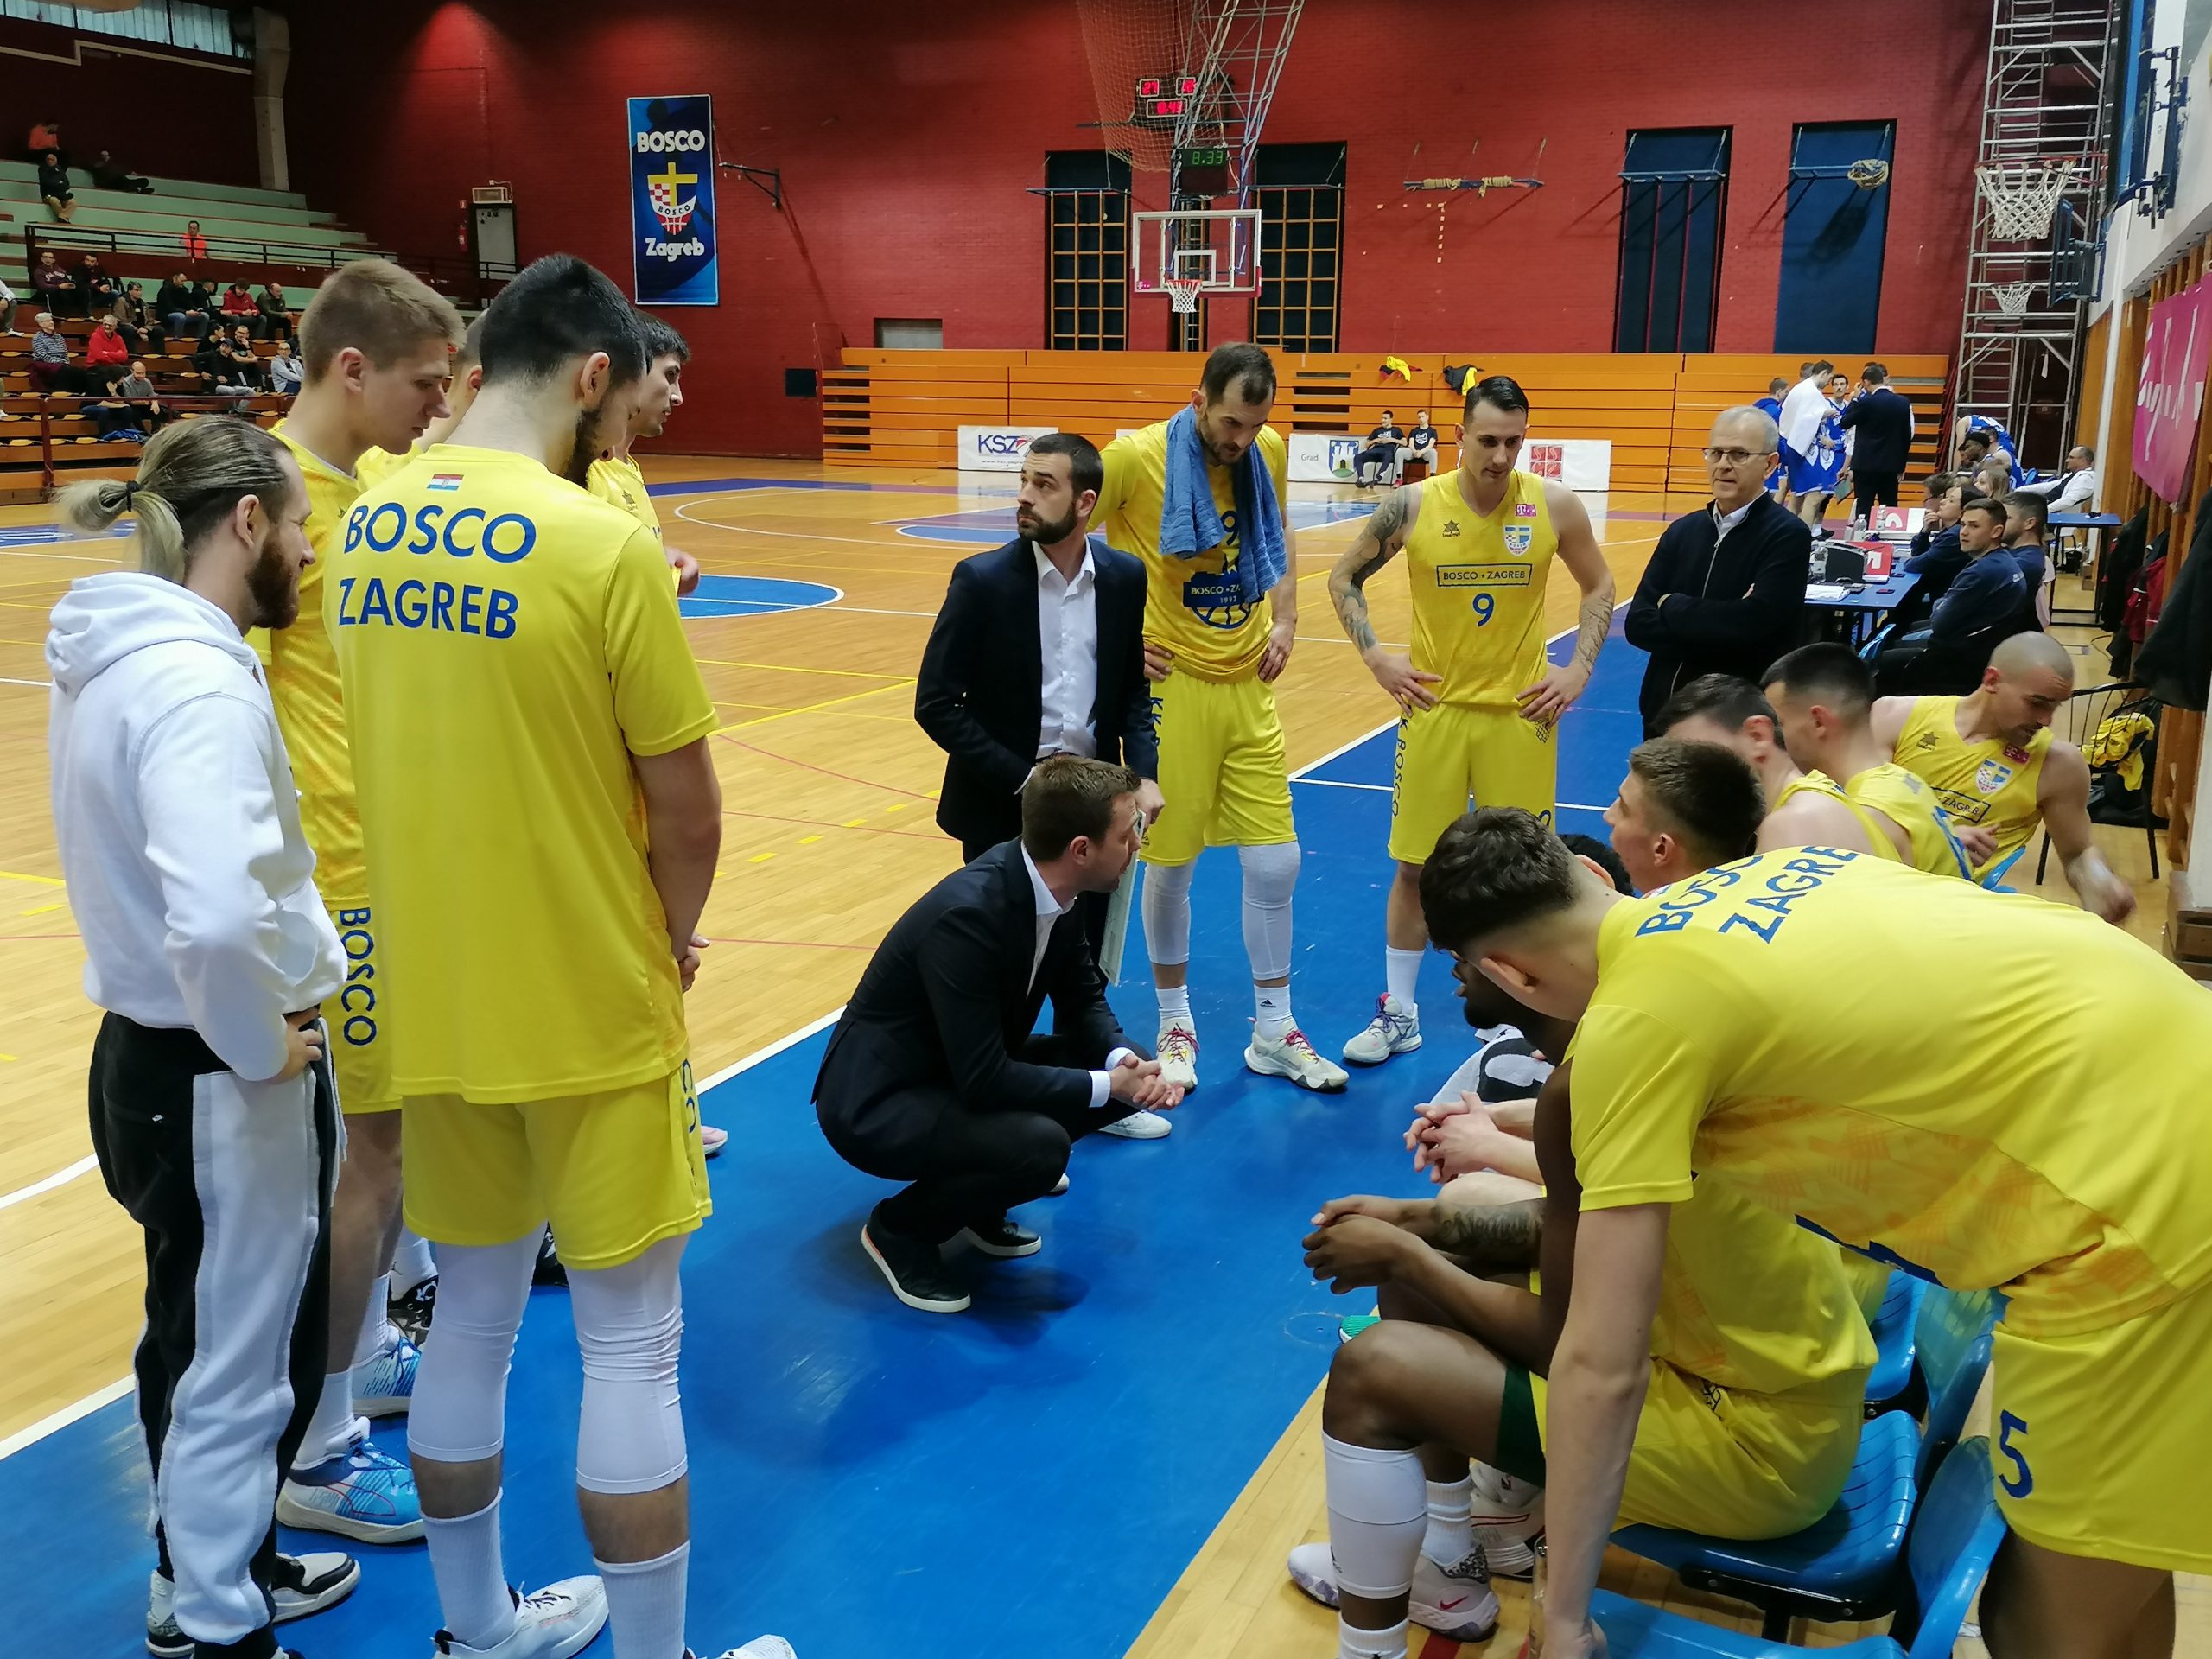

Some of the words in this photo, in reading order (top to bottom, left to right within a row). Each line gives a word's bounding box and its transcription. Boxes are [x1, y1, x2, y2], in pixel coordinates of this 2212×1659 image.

[637, 130, 706, 153] BOSCO
[658, 204, 690, 215] BOSCO
[645, 237, 705, 263] Zagreb
[977, 435, 1019, 454] KSZ
[344, 502, 537, 563] BOSCO
[1191, 587, 1224, 595] BOSCO
[1443, 571, 1478, 581] BOSCO
[1486, 570, 1526, 580] ZAGREB
[339, 578, 518, 639] ZAGREB
[1472, 593, 1494, 627] 9
[1391, 738, 1406, 817] BOSCO
[1717, 846, 1860, 944] ZAGRE
[340, 907, 377, 1046] BOSCO
[1999, 1409, 2033, 1499] 5
